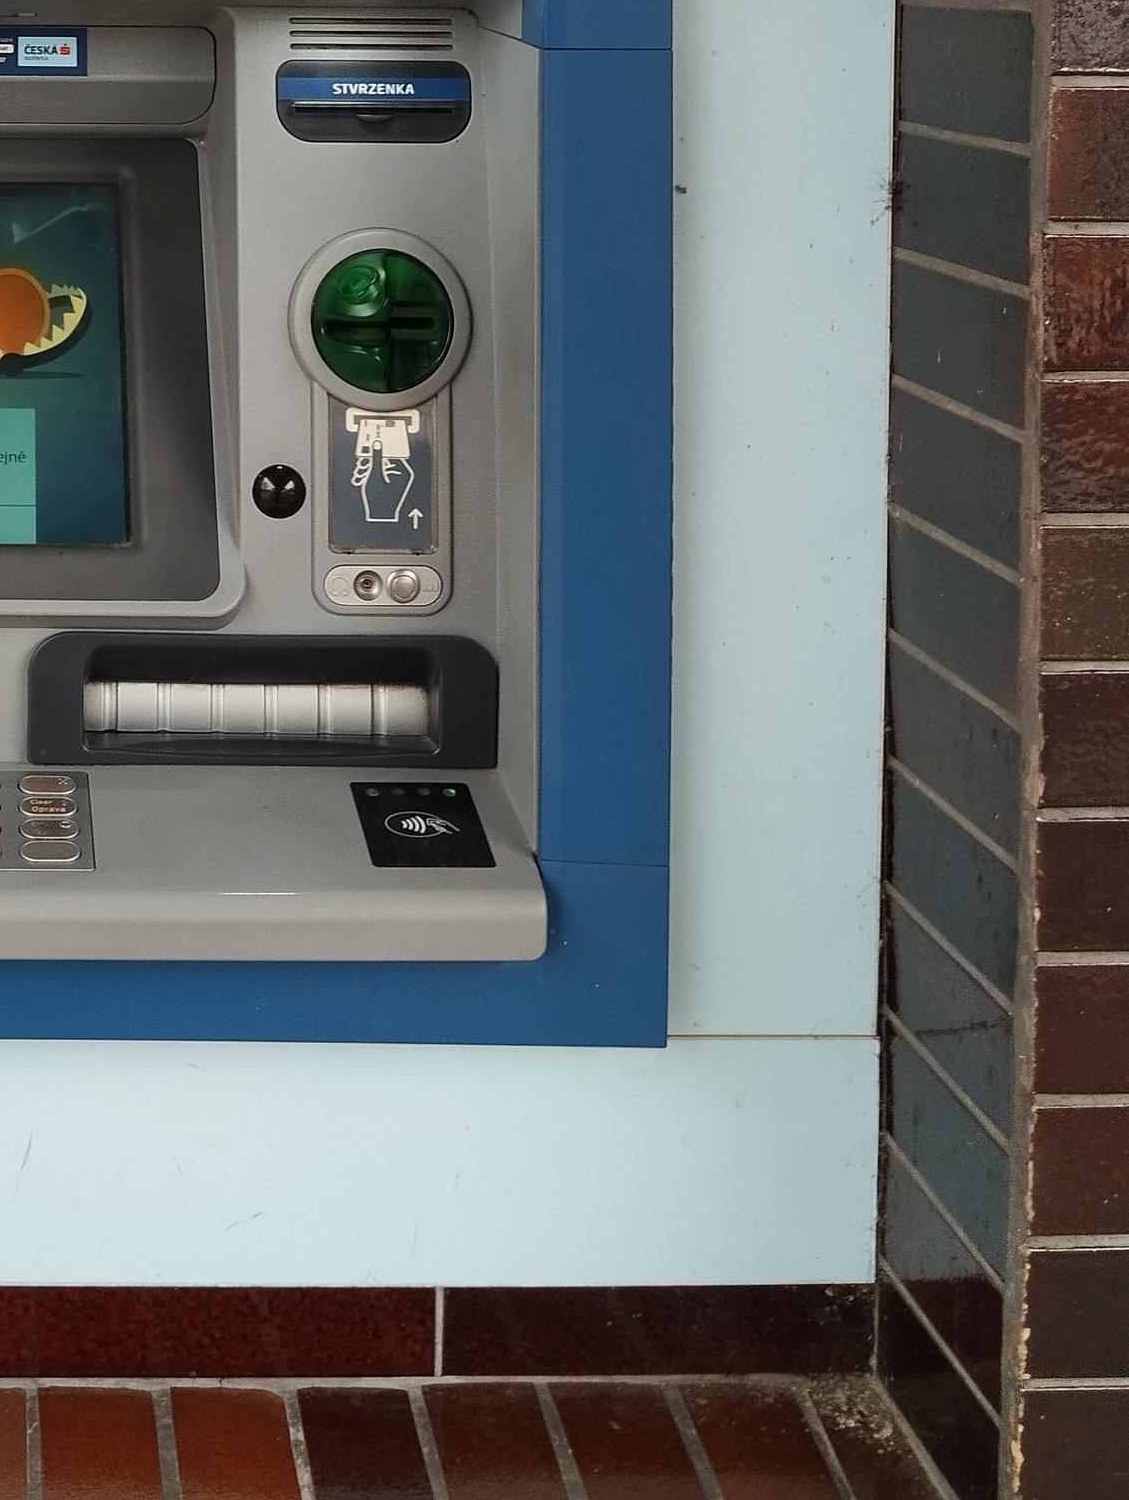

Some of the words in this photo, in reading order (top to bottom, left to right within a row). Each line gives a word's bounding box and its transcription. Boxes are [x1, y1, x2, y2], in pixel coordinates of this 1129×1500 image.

[24, 43, 58, 55] ČESKÁ
[332, 83, 415, 95] STVRZENKA
[31, 805, 66, 813] Oprava
